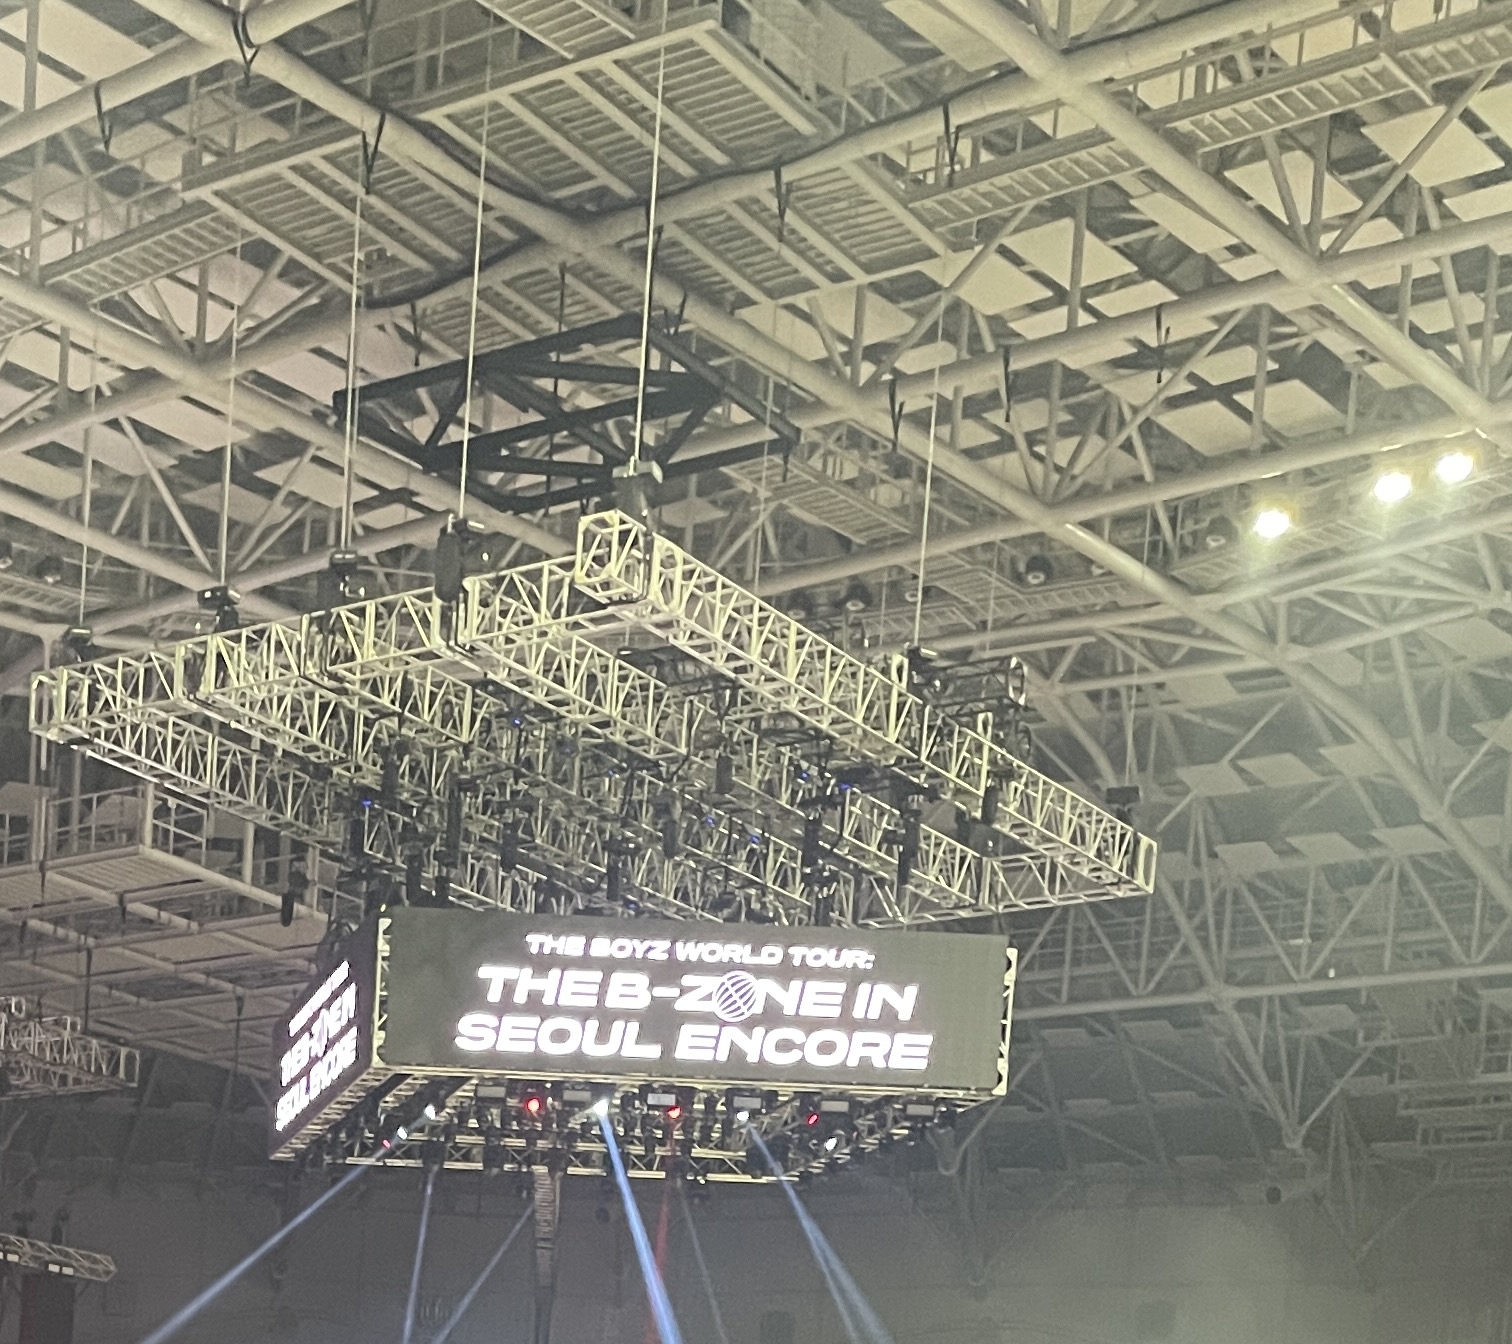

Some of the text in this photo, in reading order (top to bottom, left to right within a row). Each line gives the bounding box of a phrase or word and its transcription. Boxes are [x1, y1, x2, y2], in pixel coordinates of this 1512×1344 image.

[525, 934, 876, 970] THE BOYZ WORLD TOUR:
[477, 966, 603, 1008] THE
[852, 982, 920, 1022] IN
[454, 1013, 935, 1071] SEOUL ENCORE
